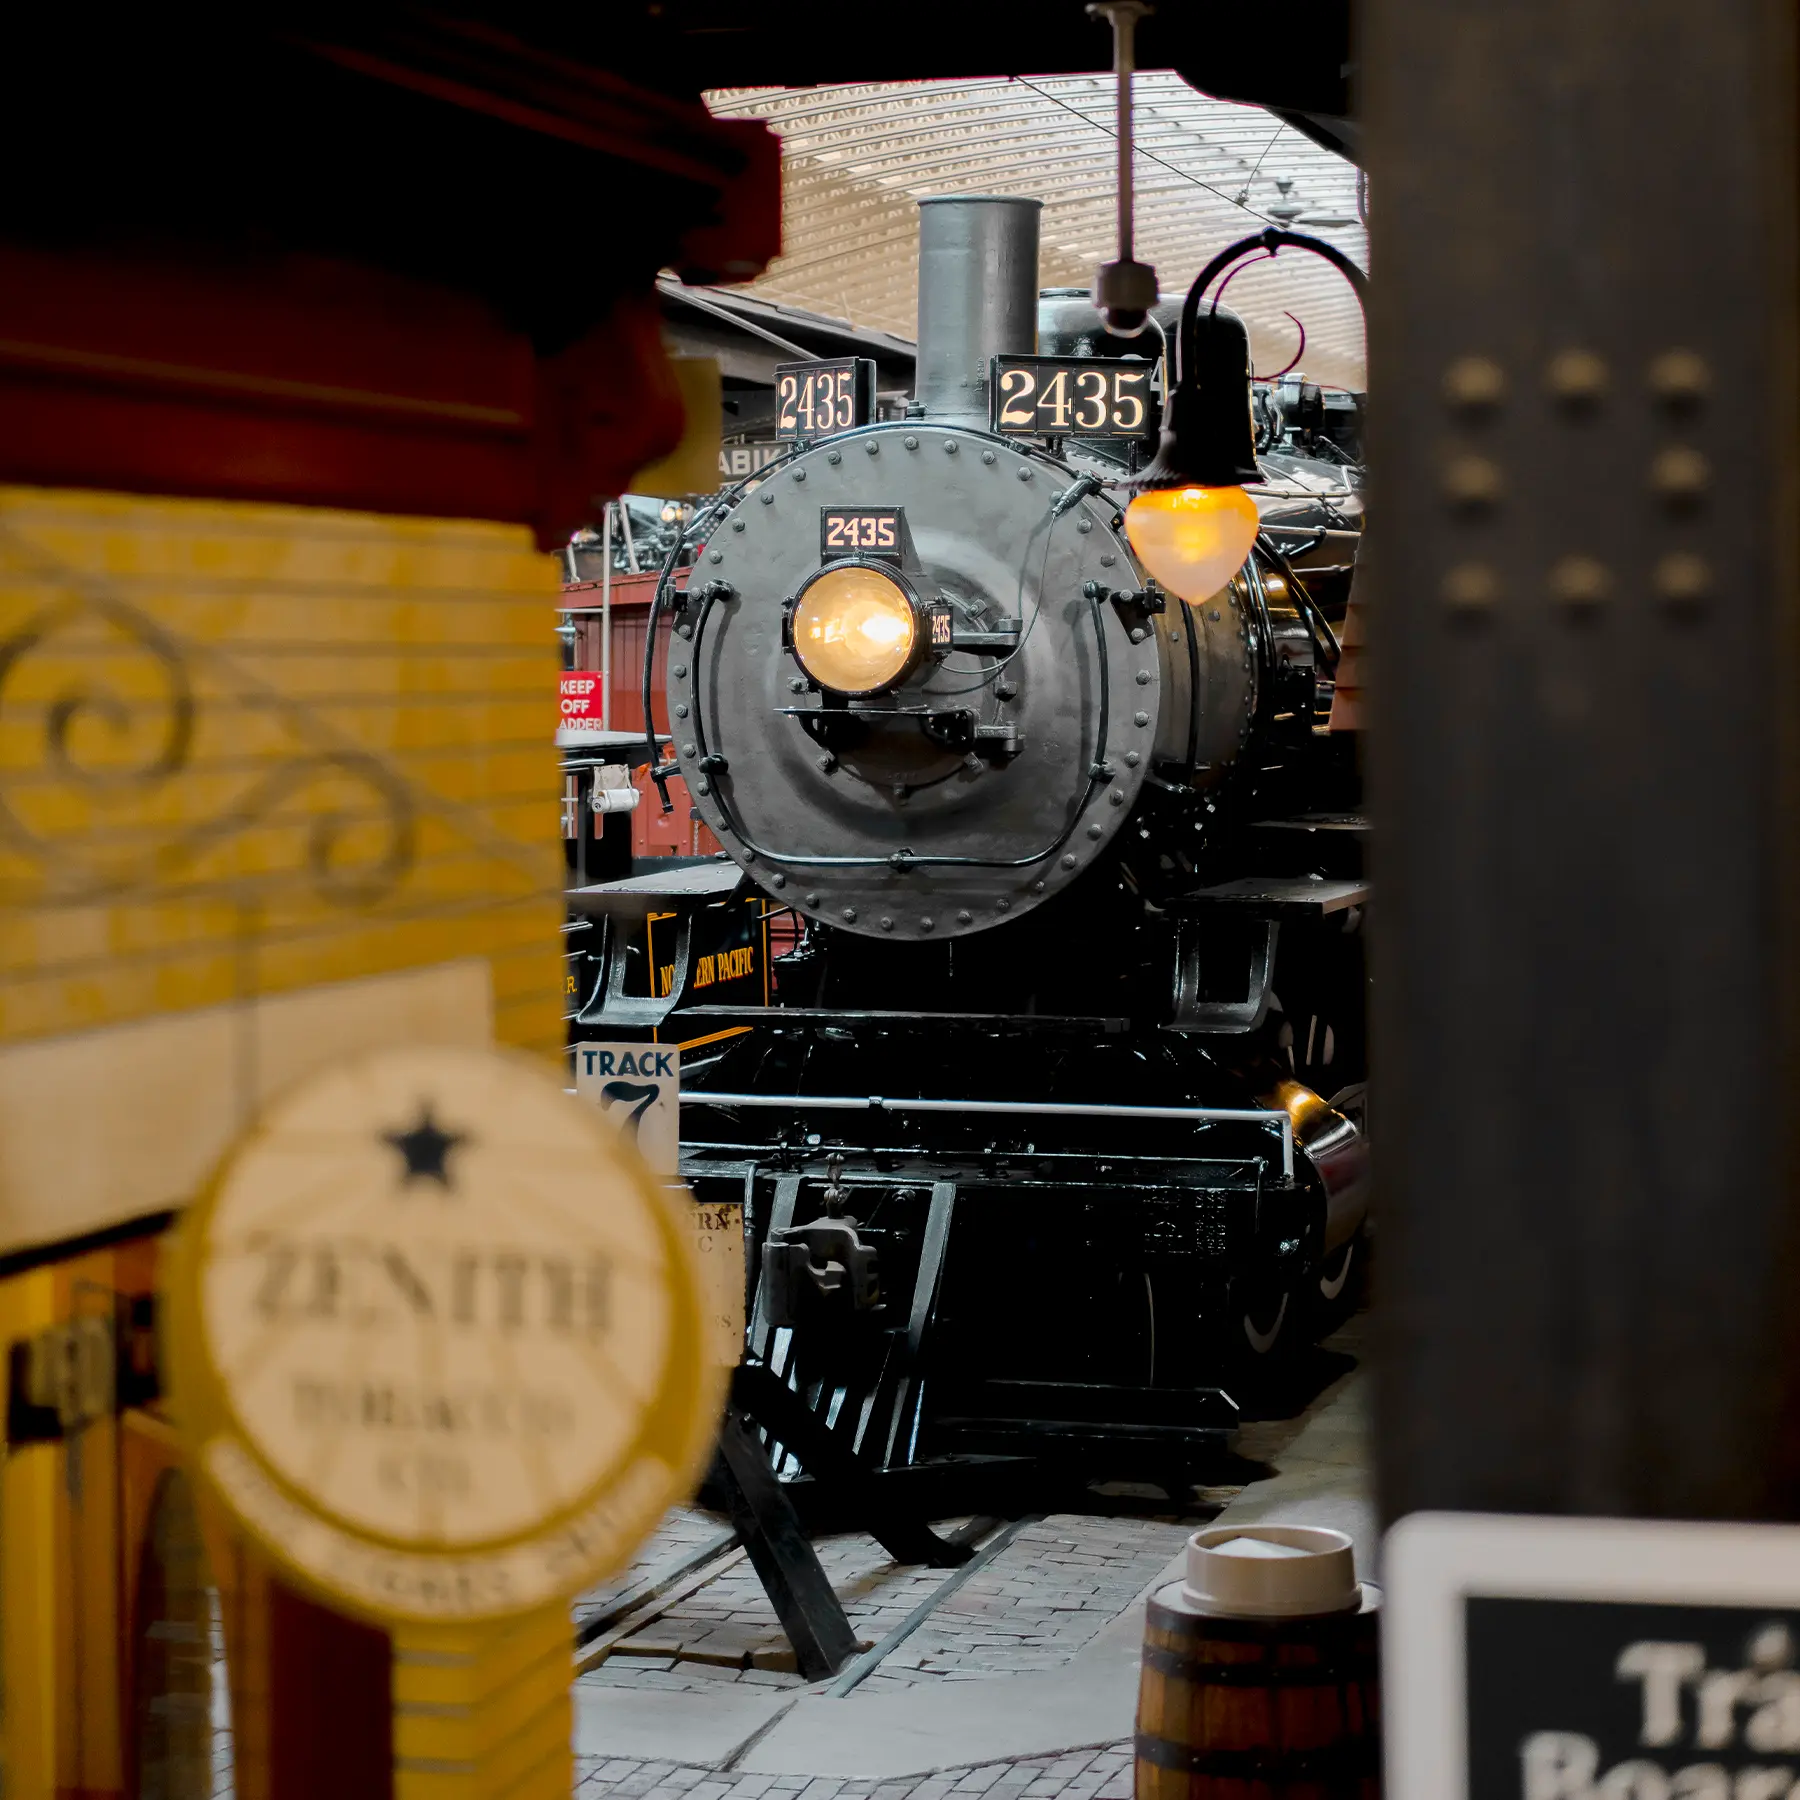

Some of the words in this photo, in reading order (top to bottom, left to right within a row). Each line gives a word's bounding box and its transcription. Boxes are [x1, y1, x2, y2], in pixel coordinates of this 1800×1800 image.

[780, 371, 853, 430] 2435
[999, 369, 1144, 428] 2435
[827, 516, 895, 547] 2435
[932, 615, 950, 643] 2435
[560, 679, 595, 695] KEEP
[560, 699, 590, 714] OFF
[717, 946, 754, 982] PACIFIC
[582, 1050, 674, 1077] TRACK
[600, 1081, 660, 1146] 7
